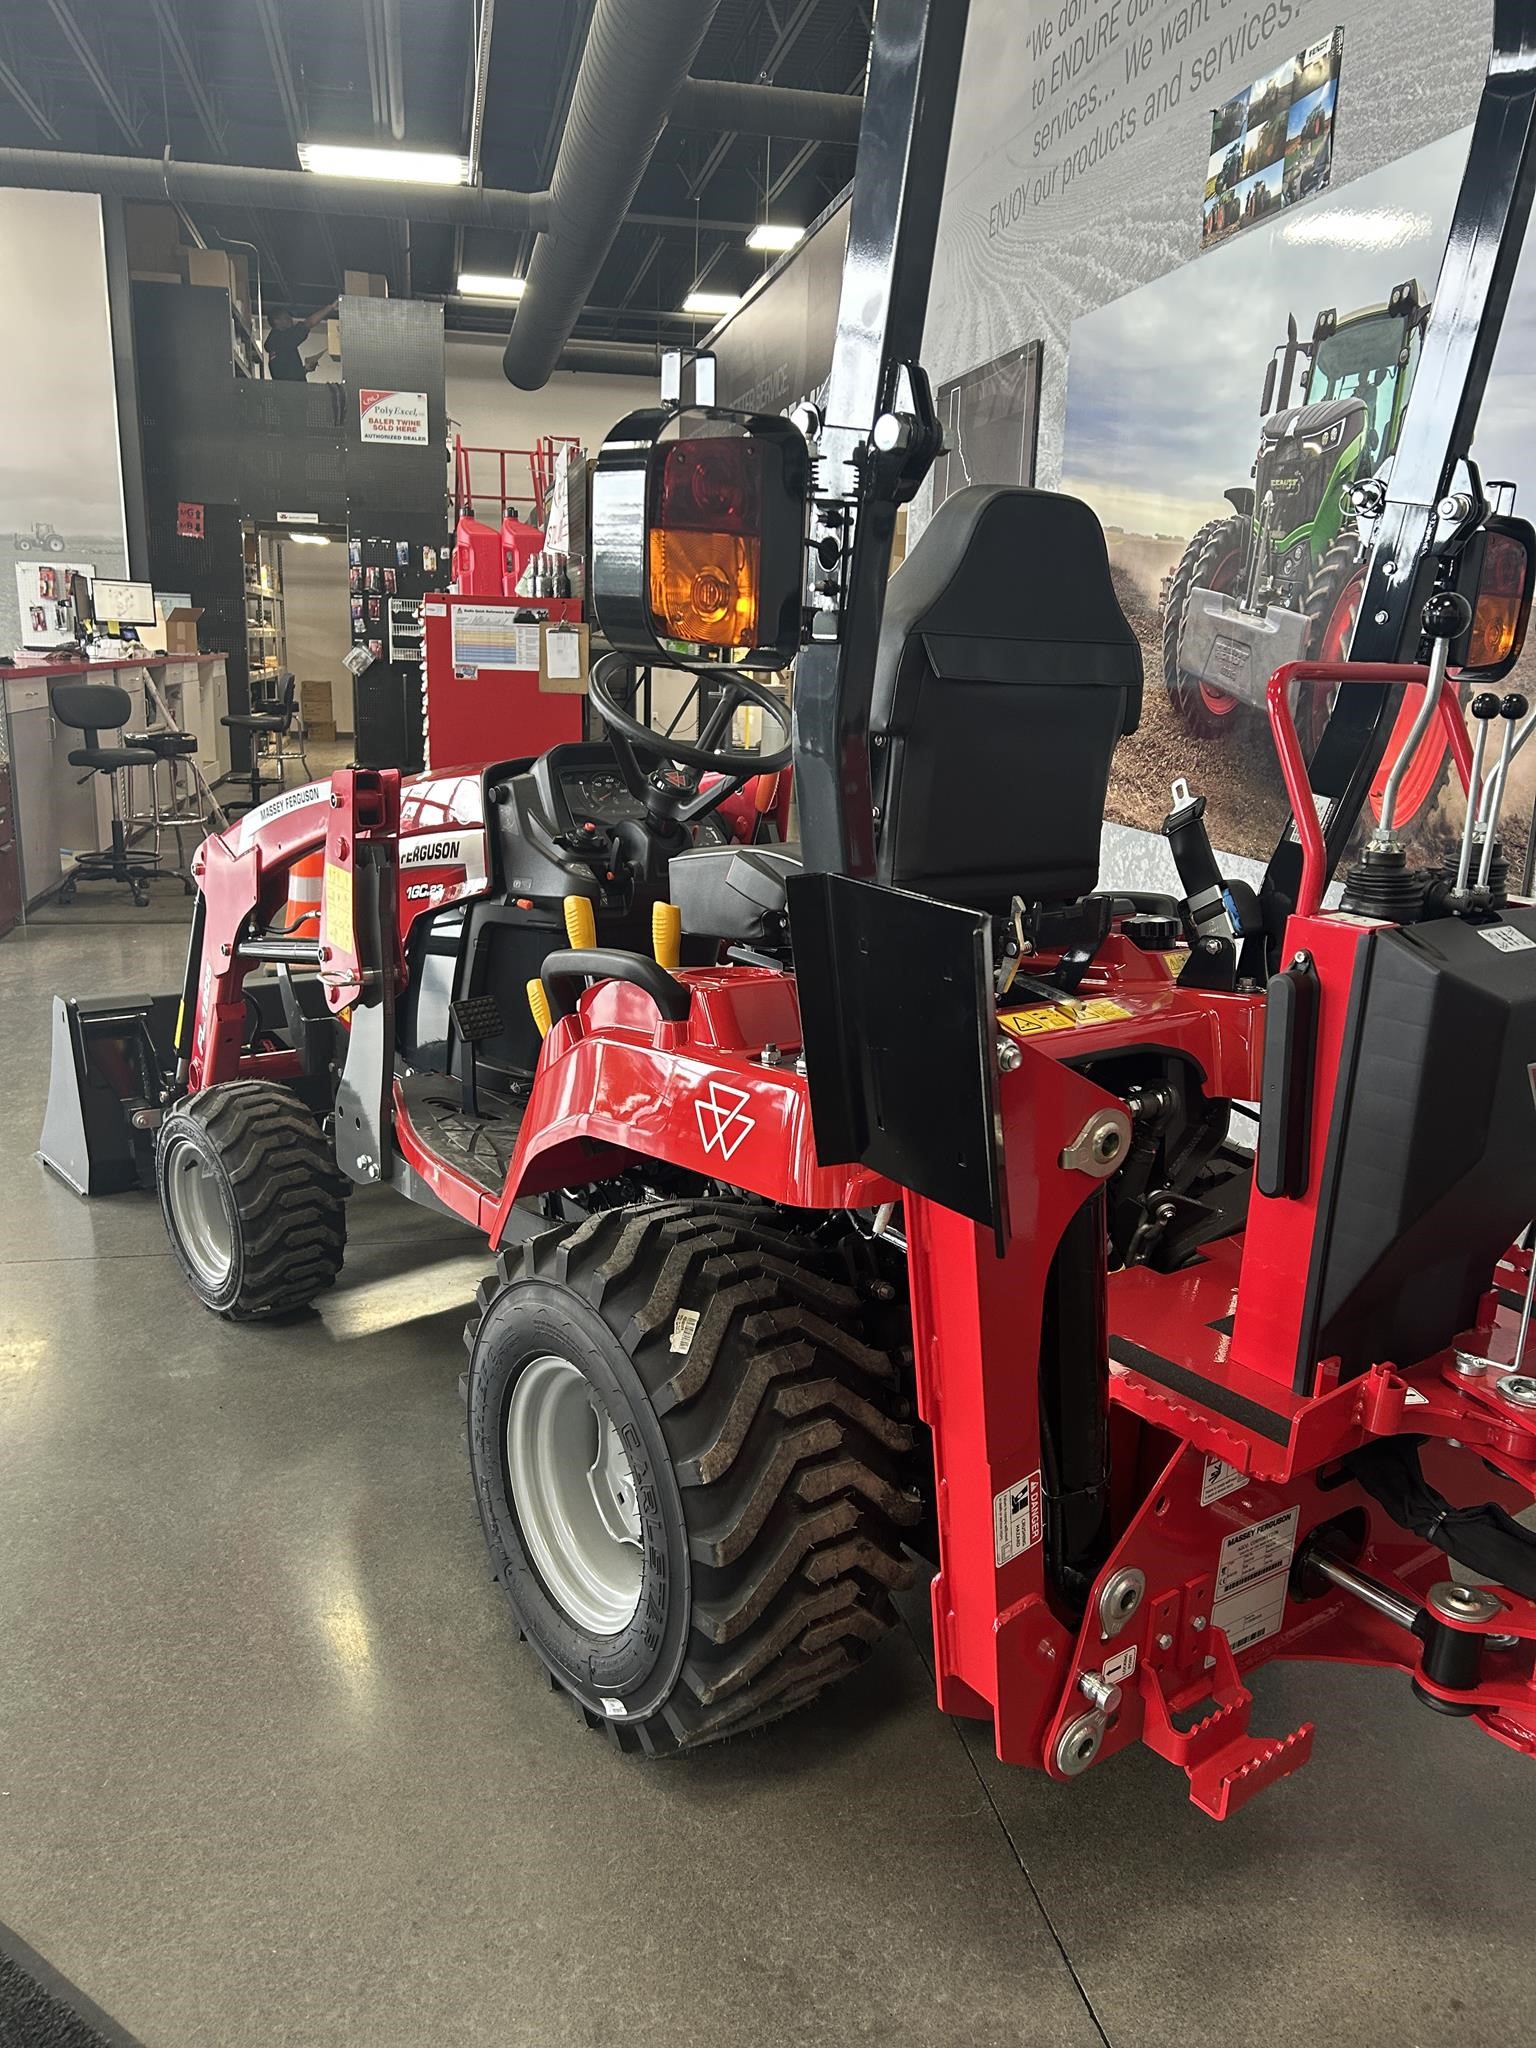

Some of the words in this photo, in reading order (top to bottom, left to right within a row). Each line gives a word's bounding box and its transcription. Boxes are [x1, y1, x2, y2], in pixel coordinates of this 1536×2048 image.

[1032, 78, 1046, 111] to
[1051, 2, 1120, 95] ENDURE
[1125, 34, 1153, 84] We
[1161, 0, 1211, 55] want
[989, 177, 1031, 238] ENJOY
[1033, 165, 1059, 206] our
[1061, 108, 1137, 195] products
[1143, 61, 1183, 127] and
[1190, 0, 1300, 92] services.
[396, 419, 421, 427] TWINE
[260, 801, 285, 822] MASSEY
[285, 786, 320, 810] FERGUSON
[1030, 1494, 1040, 1539] DANGER
[1227, 1528, 1256, 1548] MASSEY
[1257, 1513, 1292, 1534] FERGUSON
